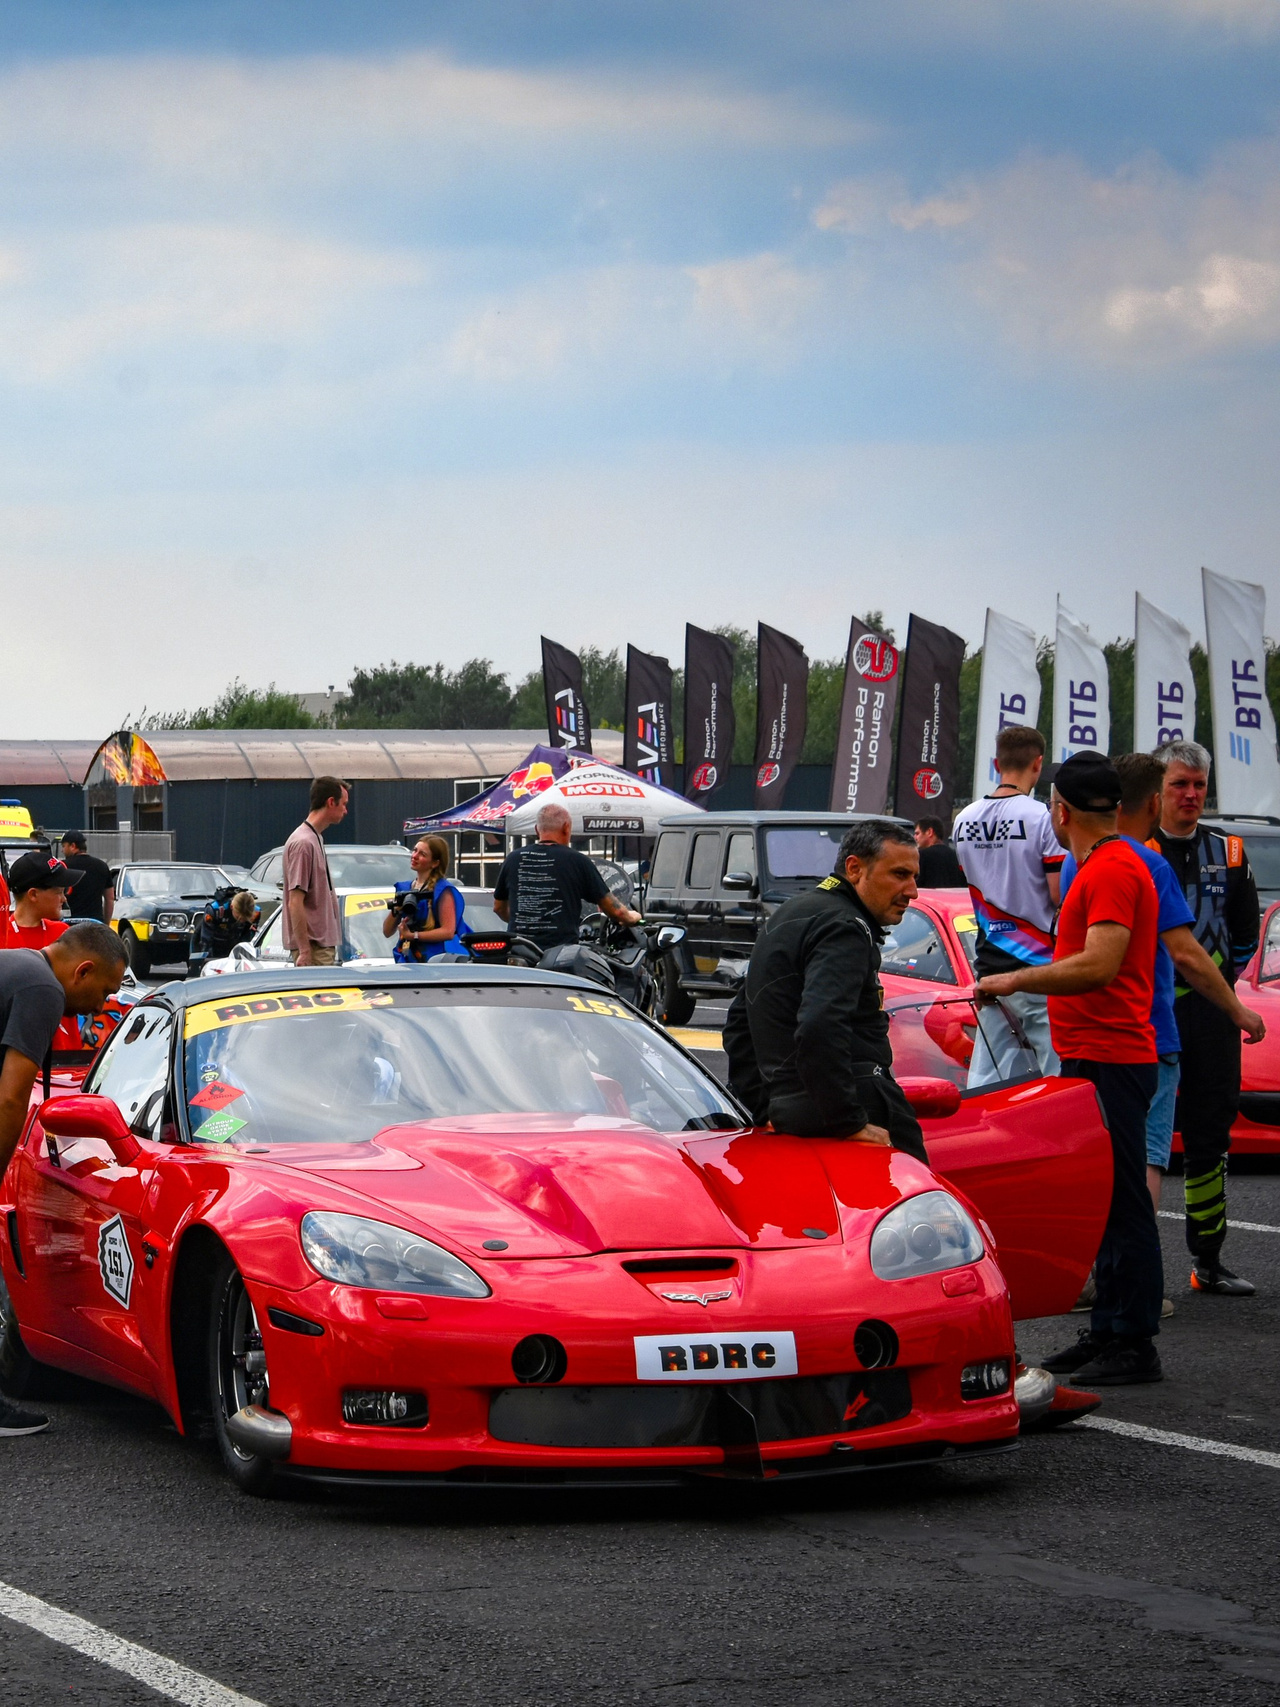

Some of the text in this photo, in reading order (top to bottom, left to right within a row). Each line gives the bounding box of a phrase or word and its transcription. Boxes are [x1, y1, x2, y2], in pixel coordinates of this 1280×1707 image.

[1231, 659, 1262, 730] ВТБ
[930, 682, 941, 764] Performance
[999, 692, 1026, 729] ТБ
[1069, 680, 1097, 746] ВТБ
[658, 702, 668, 763] PERFORMANCE
[768, 719, 778, 759] Ramon
[867, 690, 885, 768] Ramon
[921, 719, 930, 763] Ramon
[846, 687, 868, 813] Performan
[566, 784, 641, 796] MOTUL
[588, 820, 639, 829] АНГАР 13
[1211, 886, 1225, 894] ВТБ
[212, 991, 345, 1022] RDRC
[566, 995, 636, 1021] 151
[205, 1119, 234, 1129] NITROUS
[208, 1126, 233, 1135] SYSTEM
[210, 1123, 230, 1131] OXIDE
[107, 1248, 125, 1279] 151
[658, 1342, 777, 1372] RDRC
